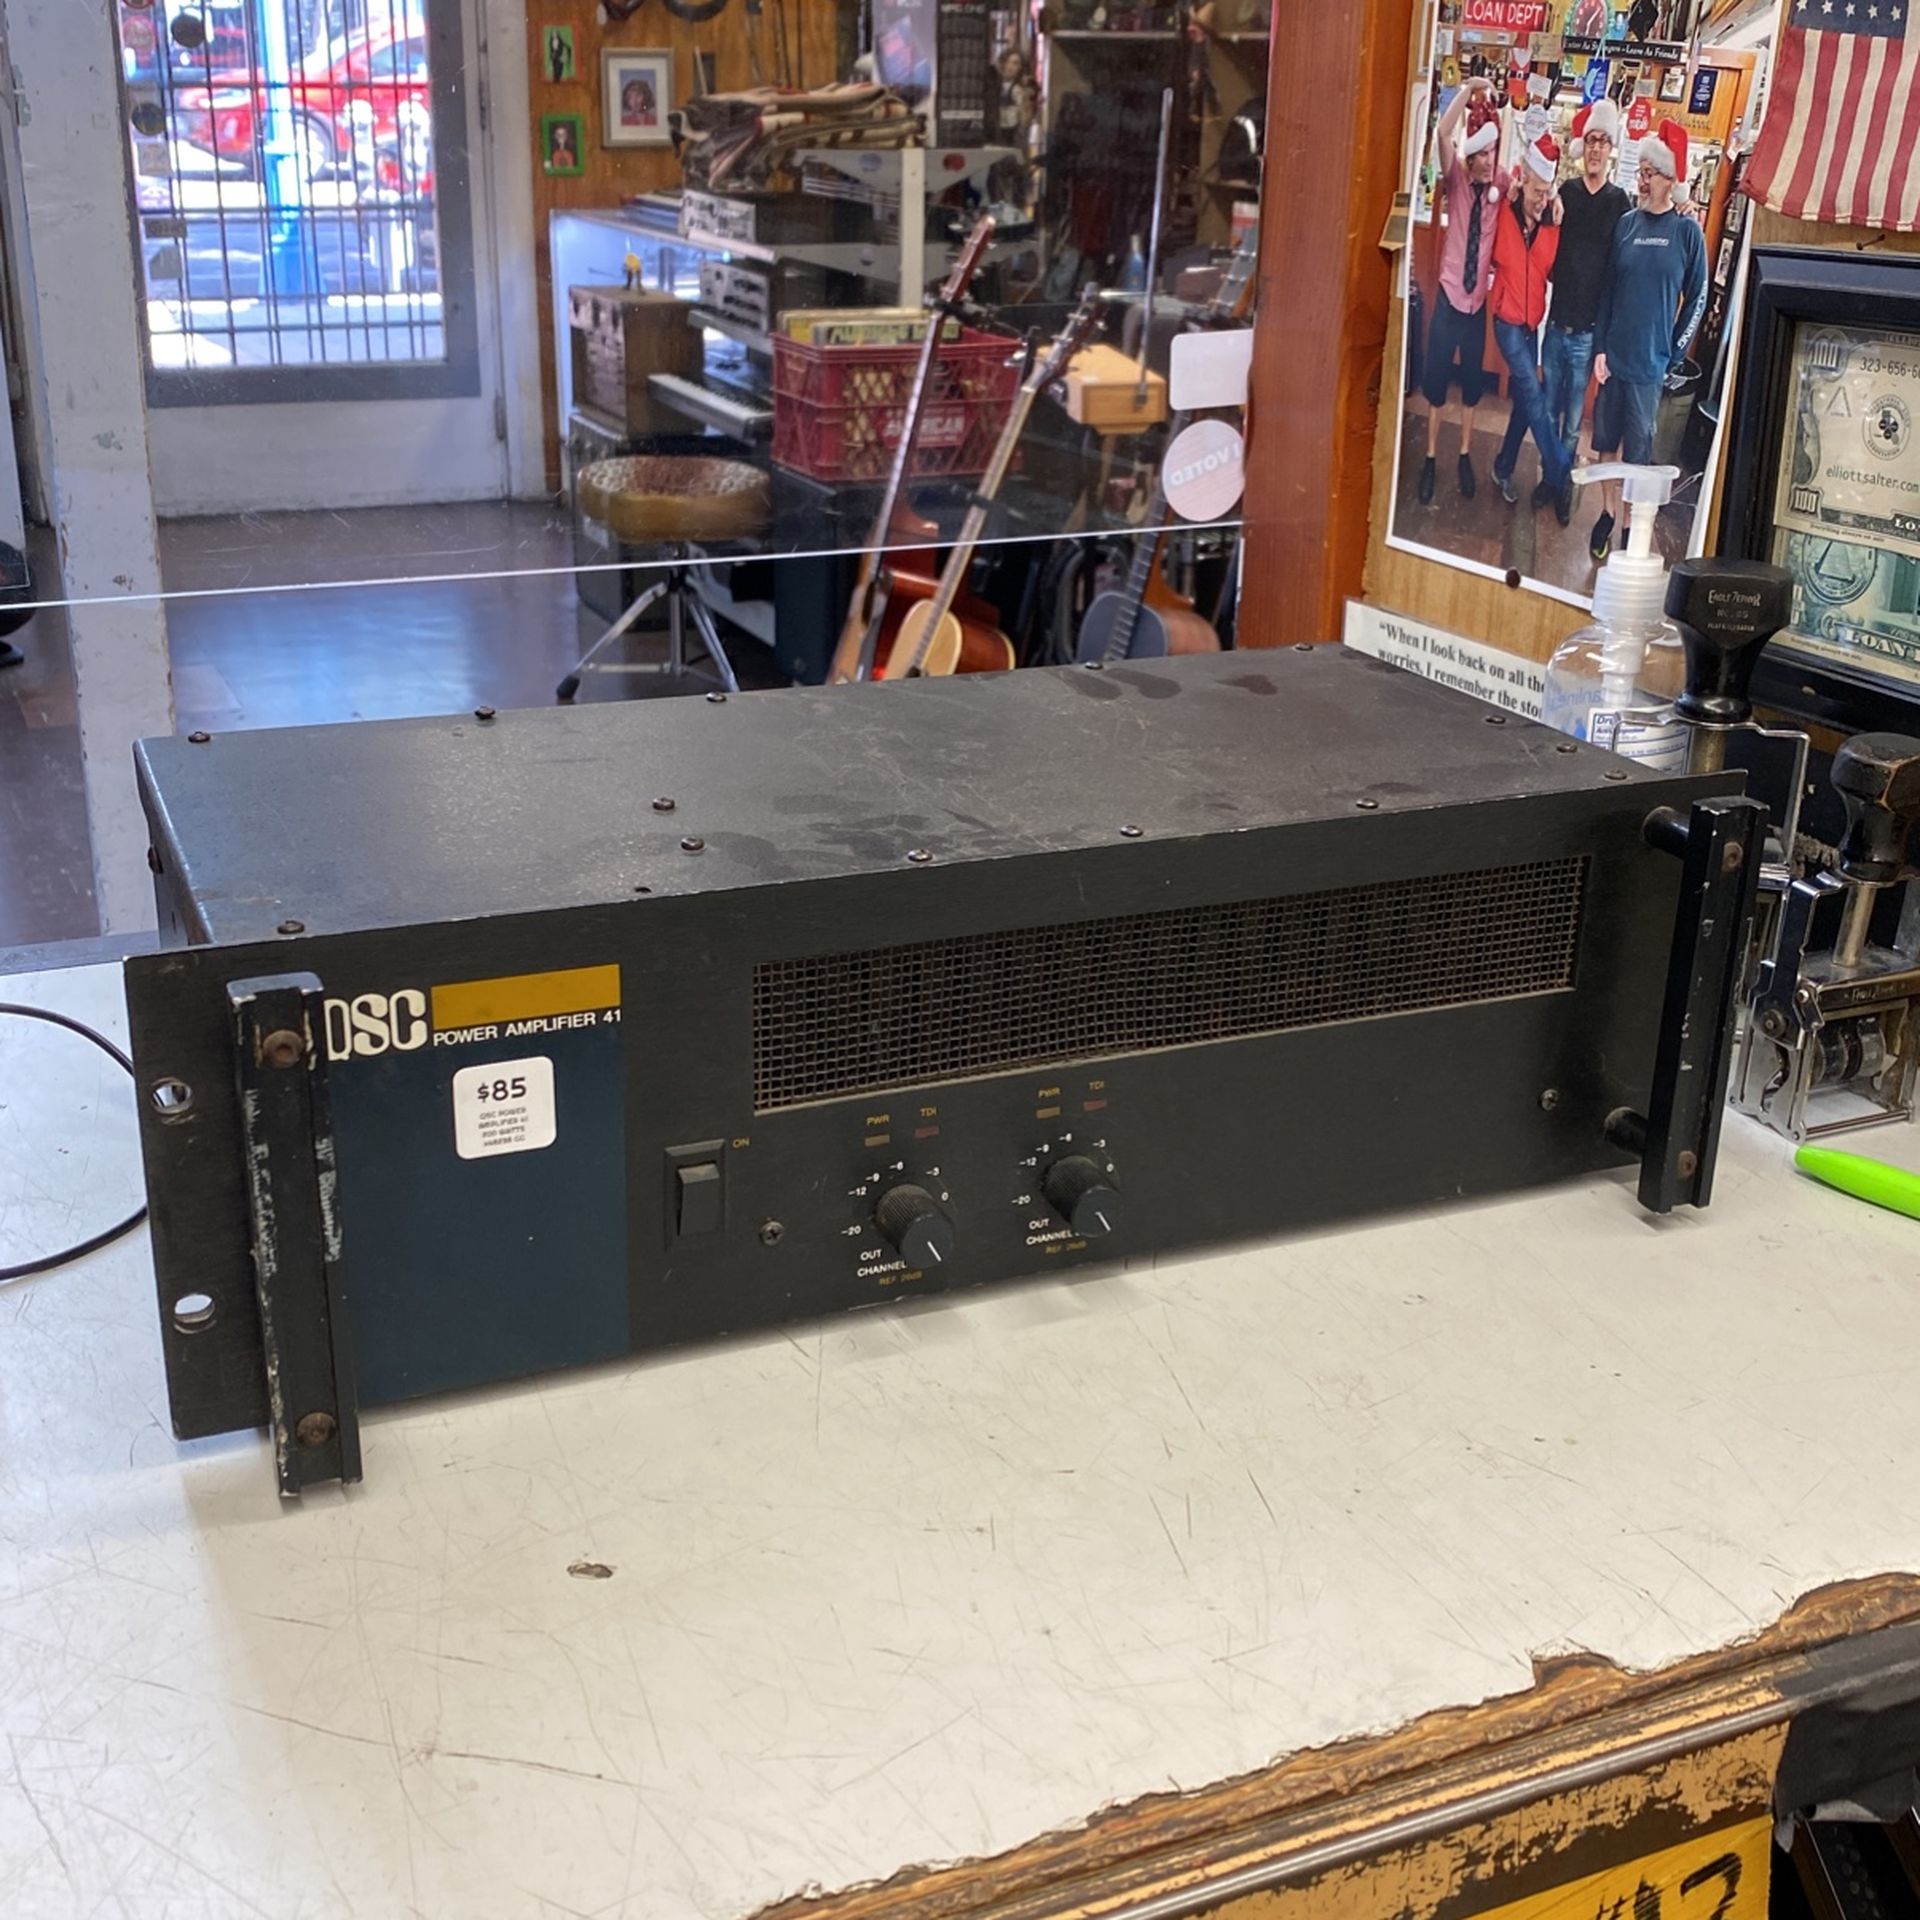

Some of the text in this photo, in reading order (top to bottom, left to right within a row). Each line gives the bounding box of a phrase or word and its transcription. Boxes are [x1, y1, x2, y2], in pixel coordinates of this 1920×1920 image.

[1464, 0, 1503, 21] LOAN
[1826, 466, 1919, 494] elliottsalter.com
[1894, 517, 1920, 533] LO
[1422, 635, 1428, 652] I
[1430, 638, 1455, 662] look
[1459, 648, 1486, 673] back
[1489, 665, 1505, 680] on
[1508, 669, 1524, 687] all
[1426, 662, 1431, 677] I
[1434, 667, 1495, 701] remember
[1497, 689, 1518, 710] the
[433, 1009, 622, 1047] POWER AMPLIFIER 41
[477, 1076, 527, 1103] $85
[1088, 1080, 1105, 1091] TDI
[1038, 1087, 1061, 1099] PWR
[919, 1106, 938, 1118] TDI
[866, 1113, 890, 1127] PWR
[733, 1138, 750, 1149] ON
[1018, 1157, 1038, 1166] -12
[848, 1186, 867, 1197] -12
[1011, 1194, 1031, 1205] -20
[840, 1225, 862, 1236] -20
[1029, 1218, 1050, 1231] OUT
[1026, 1229, 1073, 1246] CHANNEL
[860, 1248, 883, 1262] OUT
[857, 1260, 907, 1278] CHANNEL
